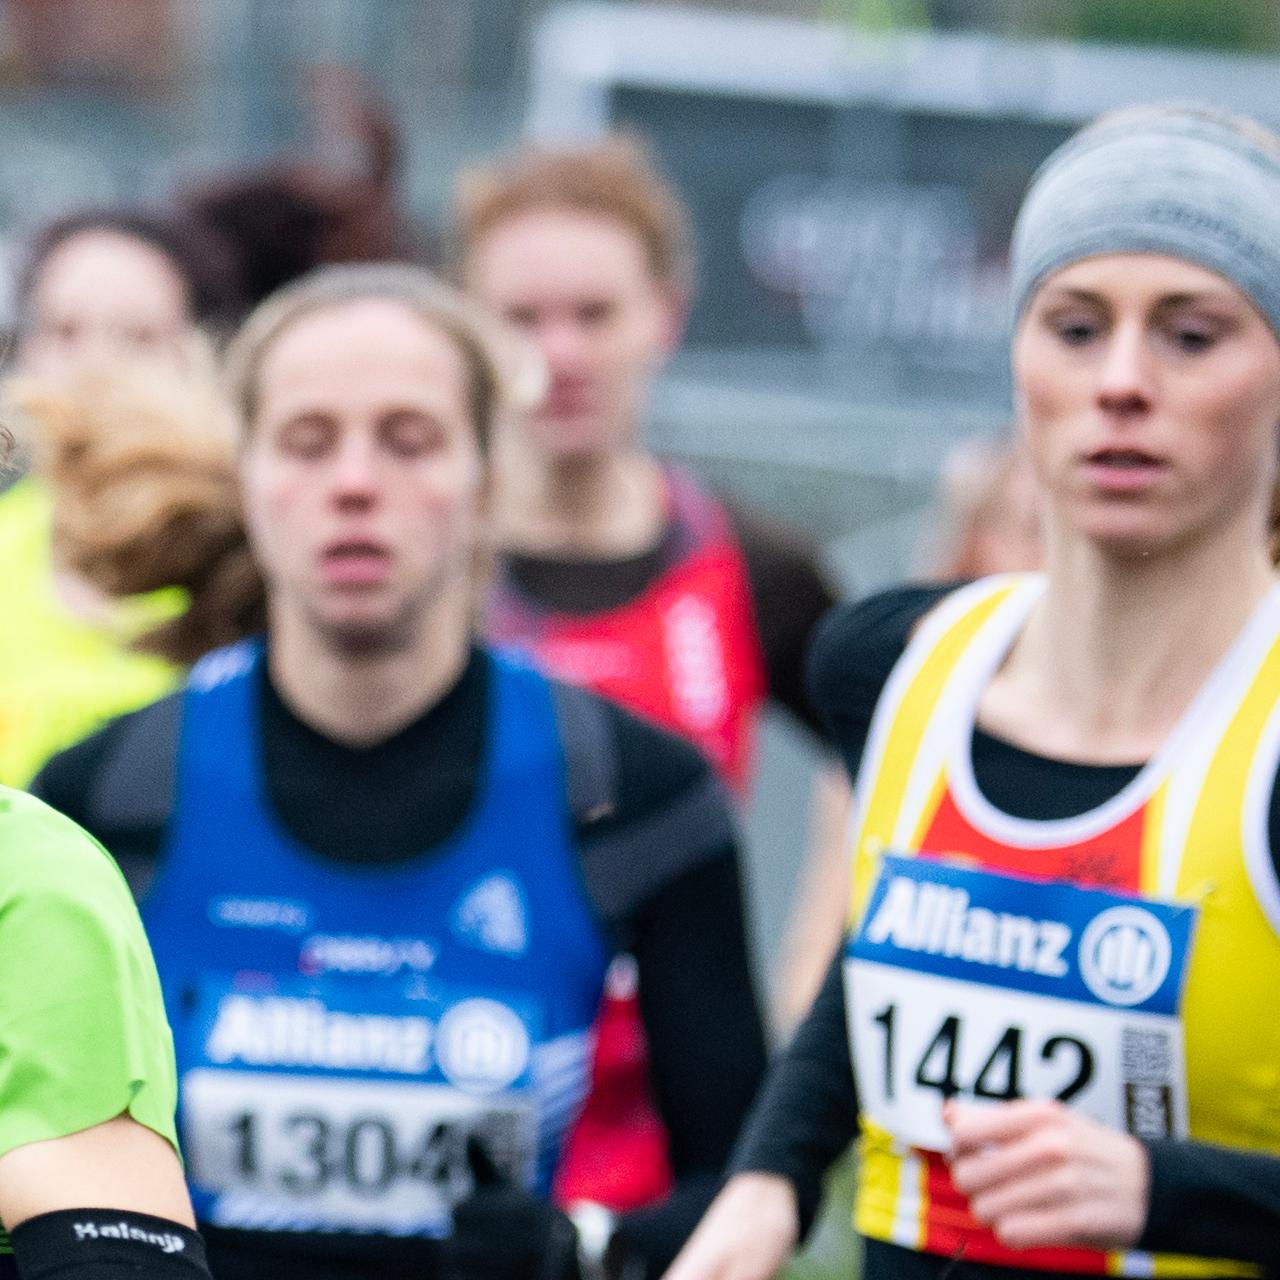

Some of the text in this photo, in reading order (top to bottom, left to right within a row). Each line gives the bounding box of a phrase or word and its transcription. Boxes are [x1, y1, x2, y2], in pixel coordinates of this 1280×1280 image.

[867, 874, 1073, 978] Allianz
[210, 997, 431, 1073] Allianz
[873, 1002, 1095, 1102] 1442
[230, 1110, 453, 1195] 1304
